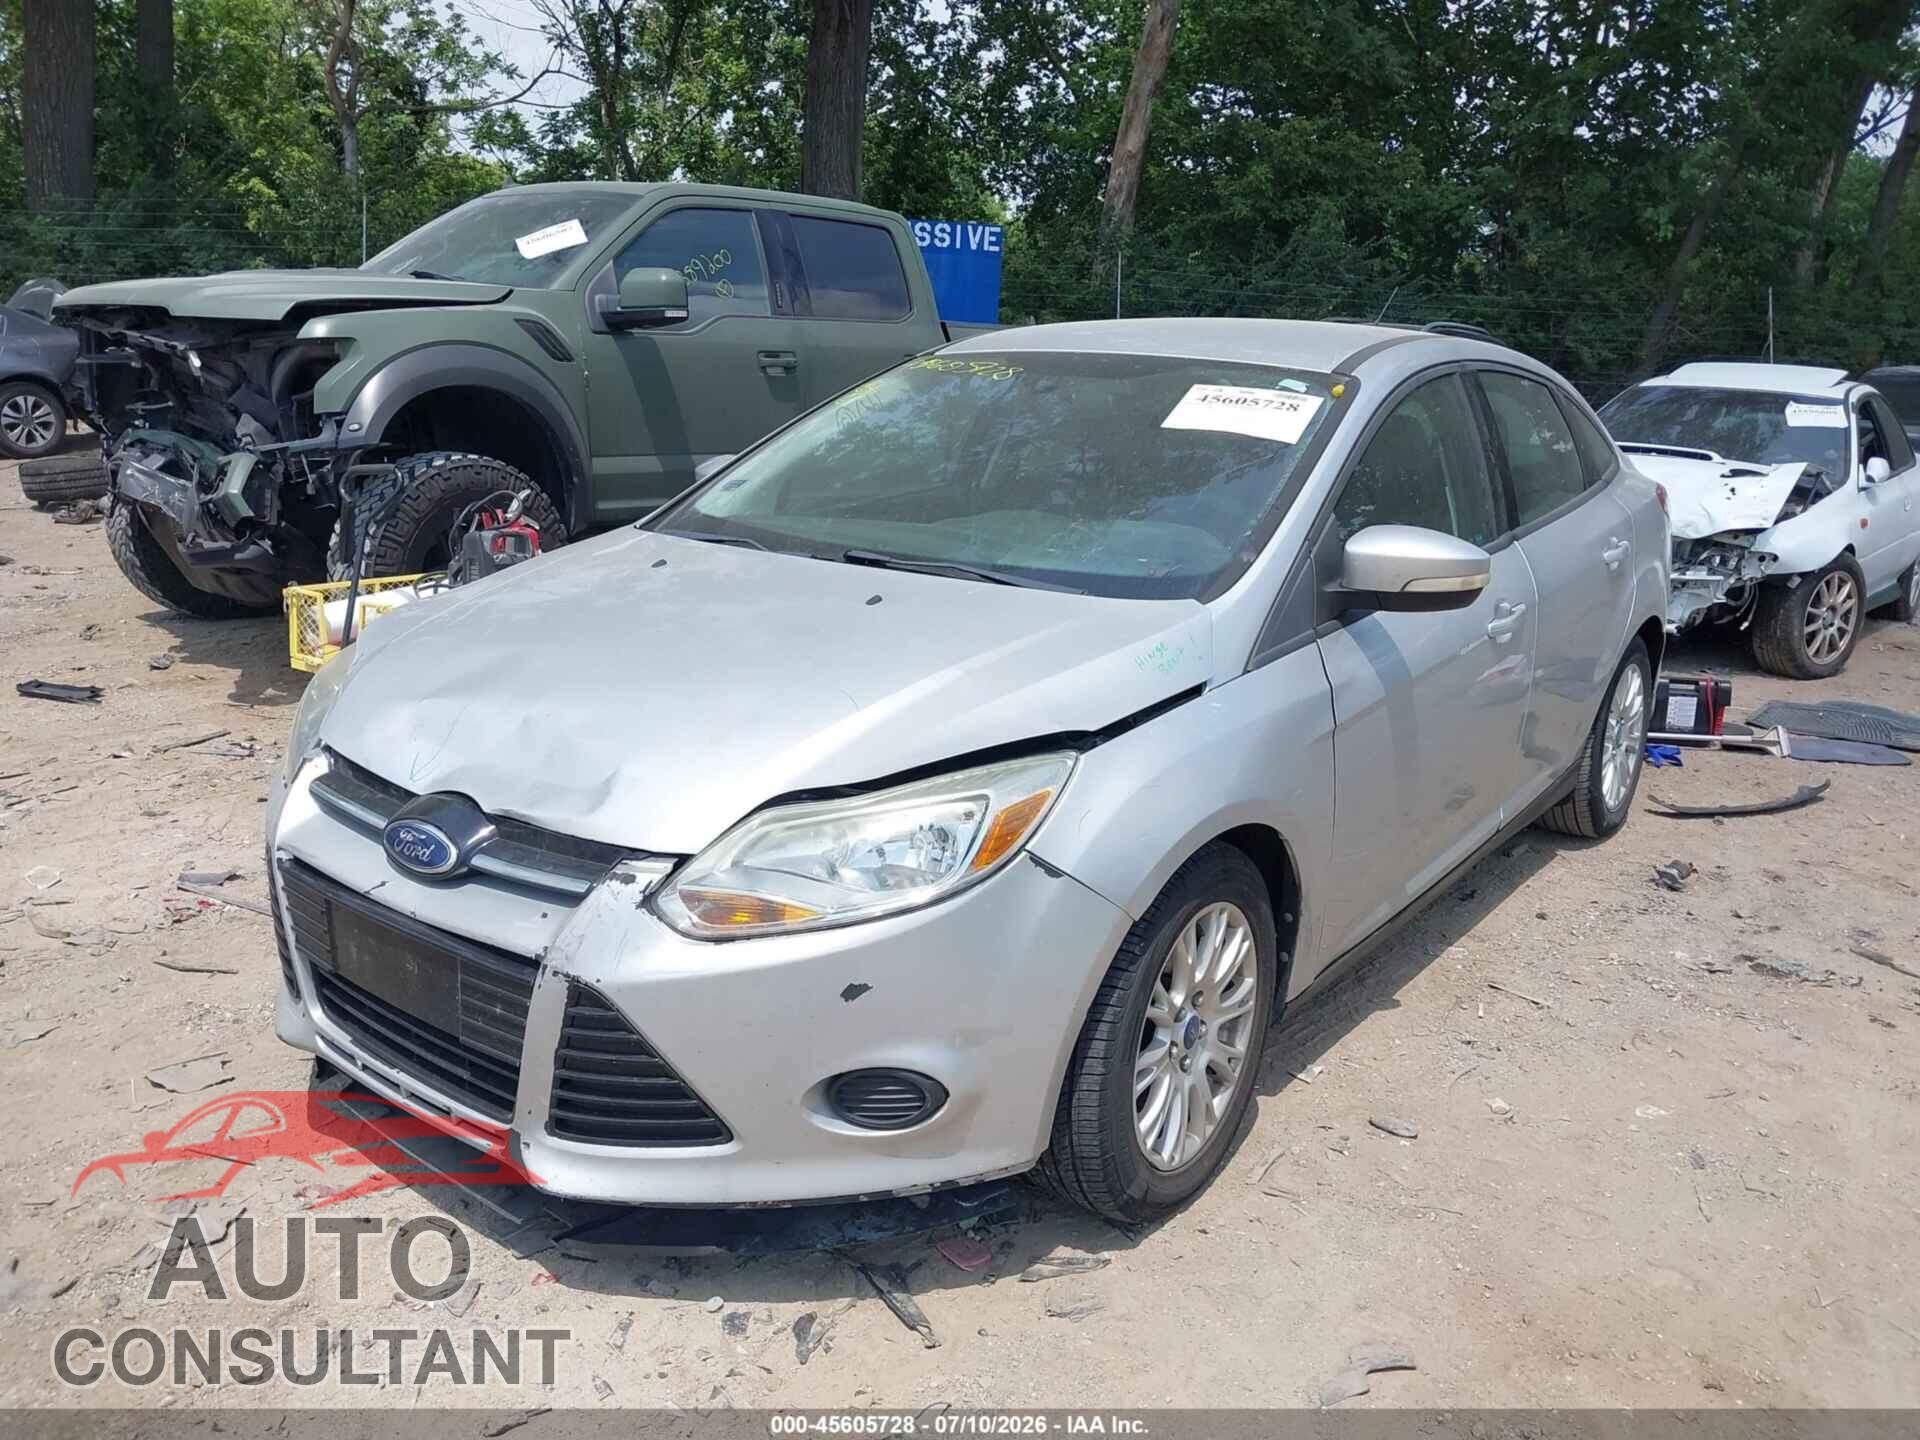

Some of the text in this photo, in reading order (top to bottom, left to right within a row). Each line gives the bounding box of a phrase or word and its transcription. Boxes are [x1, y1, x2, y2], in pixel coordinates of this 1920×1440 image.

[908, 220, 1002, 252] SSIVE
[1195, 393, 1301, 413] 45605728
[393, 827, 436, 863] Ford
